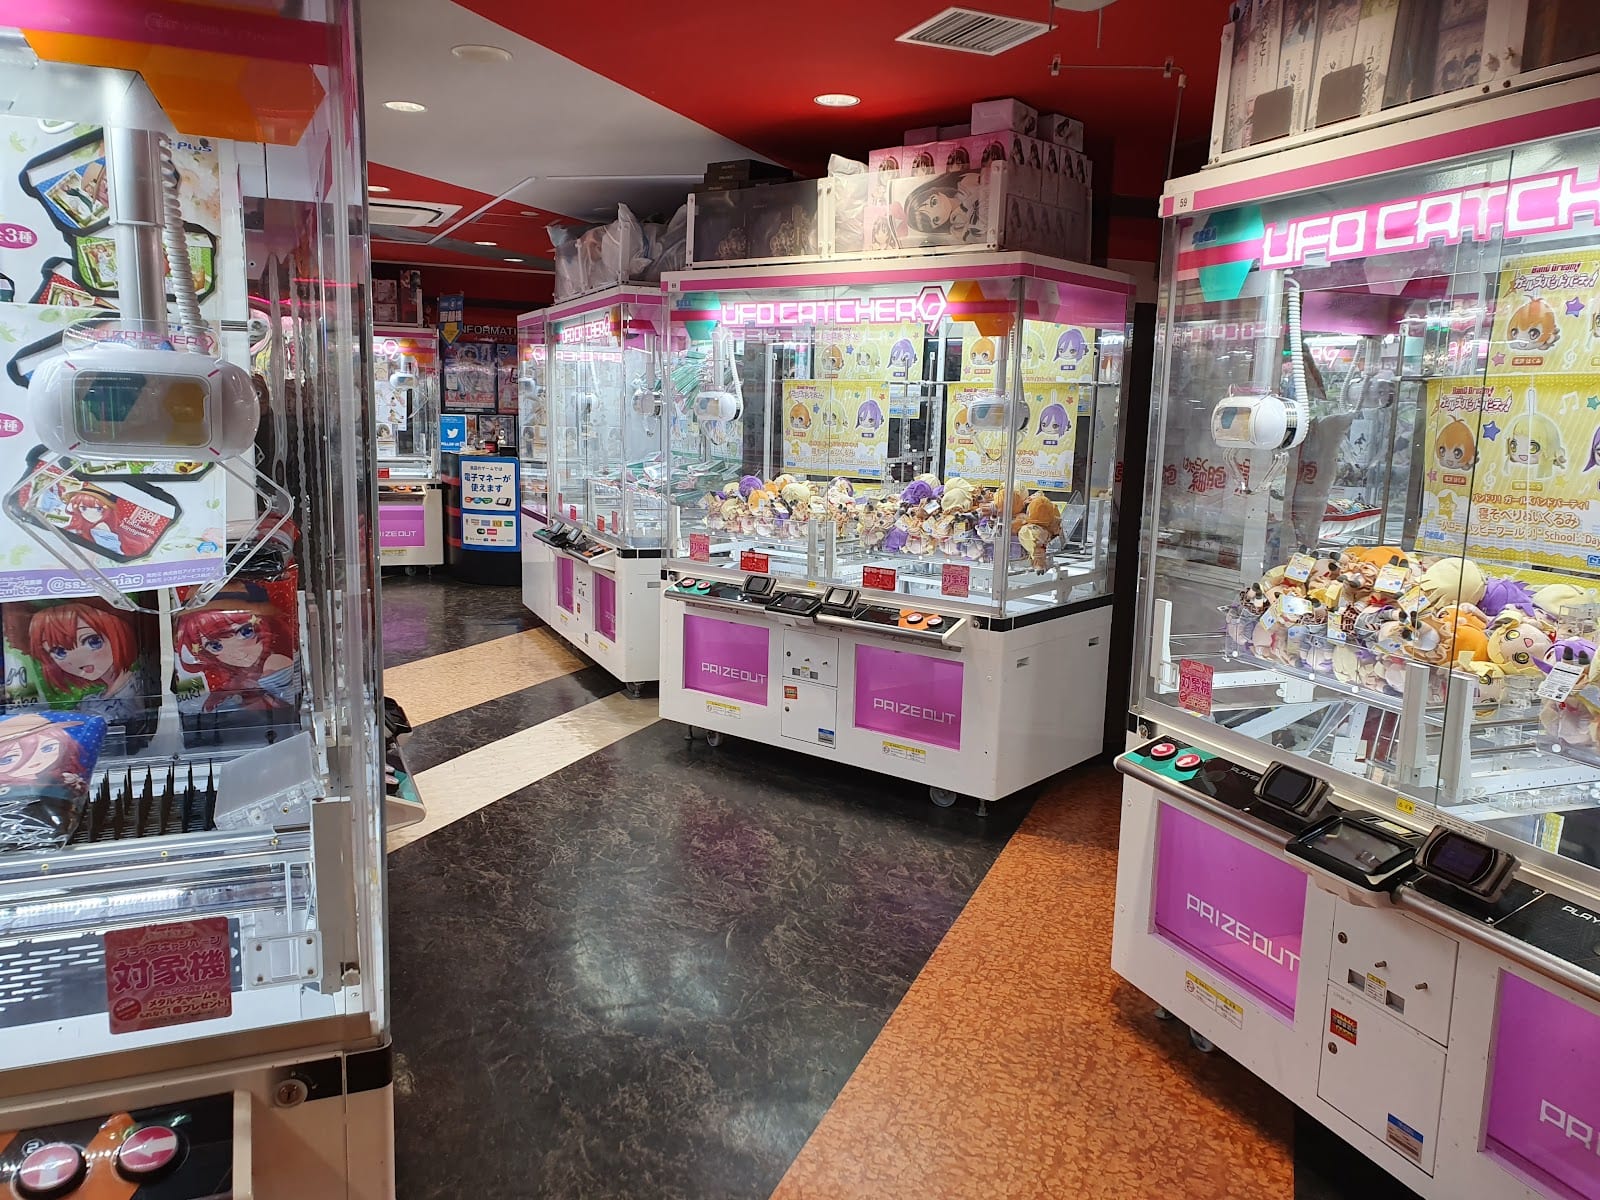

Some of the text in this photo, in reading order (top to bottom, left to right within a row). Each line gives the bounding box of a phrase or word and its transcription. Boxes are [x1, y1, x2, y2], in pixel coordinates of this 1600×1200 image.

[1179, 198, 1187, 208] 59
[1262, 210, 1368, 267] UFO
[721, 302, 775, 325] UFO
[779, 297, 917, 325] CATCHER
[0, 419, 18, 433] 種
[464, 473, 511, 483] 電子マネーが
[471, 484, 503, 493] 使えます
[1478, 507, 1580, 528] 寝そべりぬいぐるみ
[1544, 529, 1576, 543] School
[112, 948, 227, 993] 対象機
